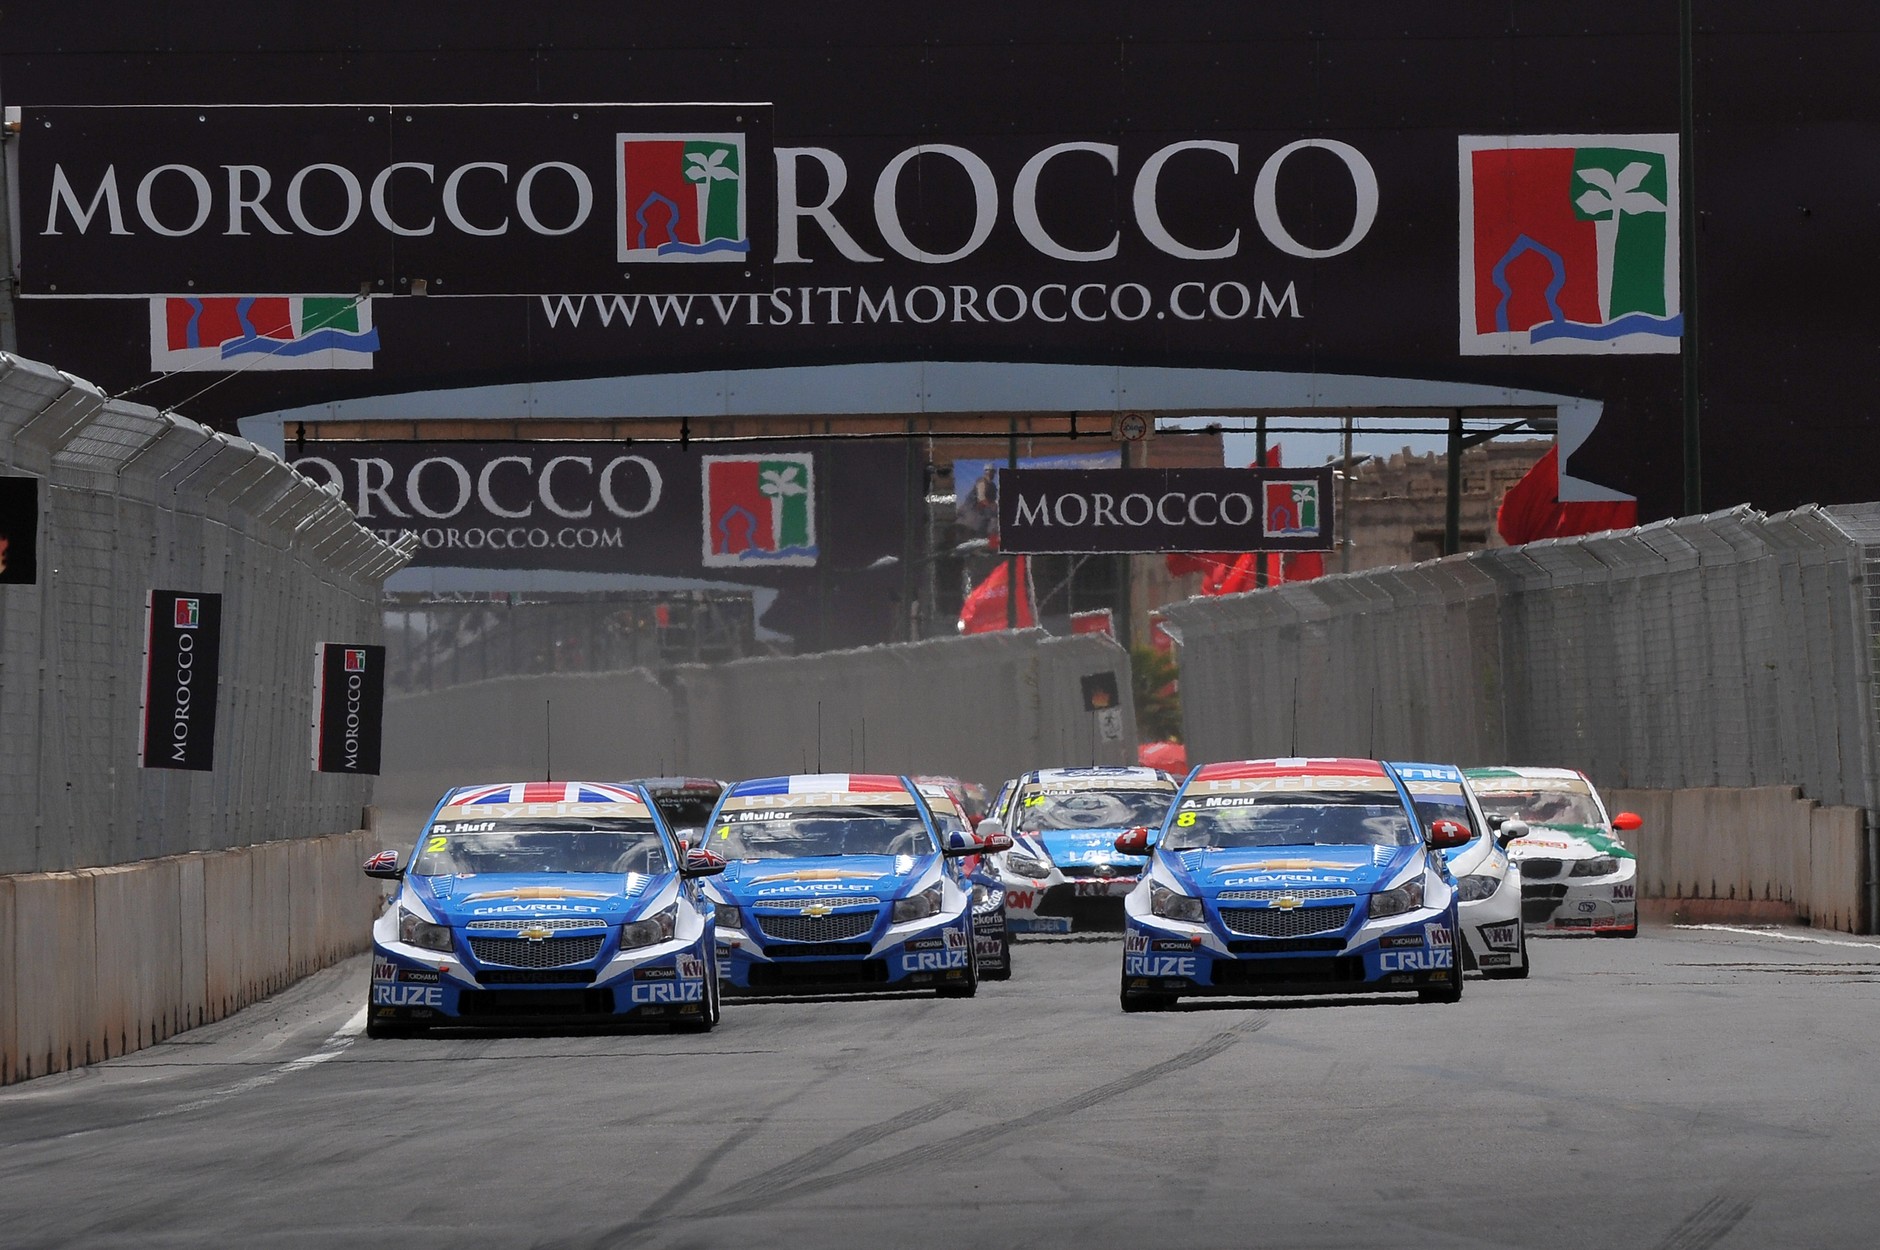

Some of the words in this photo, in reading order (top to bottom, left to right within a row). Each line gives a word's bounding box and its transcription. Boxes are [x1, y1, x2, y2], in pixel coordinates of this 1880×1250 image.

[40, 161, 593, 237] MOROCCO
[1012, 492, 1253, 527] MOROCCO
[172, 633, 194, 762] MOROCCO
[345, 674, 362, 769] MOROCCO
[1209, 775, 1373, 792] HyFlex
[745, 793, 893, 807] HyFlex
[1023, 795, 1045, 808] 14
[1181, 799, 1201, 809] A.
[1206, 797, 1255, 807] Menu
[461, 803, 626, 818] HyFlex
[722, 812, 736, 823] Y.
[740, 811, 792, 822] Muller
[1177, 812, 1196, 827] 8
[433, 823, 451, 833] R.
[455, 822, 496, 833] Huff
[717, 826, 730, 840] 1
[427, 837, 447, 853] 2
[1225, 874, 1350, 887] CHEVROLET
[758, 884, 873, 896] CHEVROLET
[1613, 885, 1634, 898] KW
[474, 903, 600, 916] CHEVROLET
[1391, 937, 1423, 945] YOKOHAMA
[1493, 929, 1513, 942] KW
[1126, 937, 1146, 953] KW
[374, 963, 396, 980] KW
[408, 972, 438, 981] YOKOHAMA
